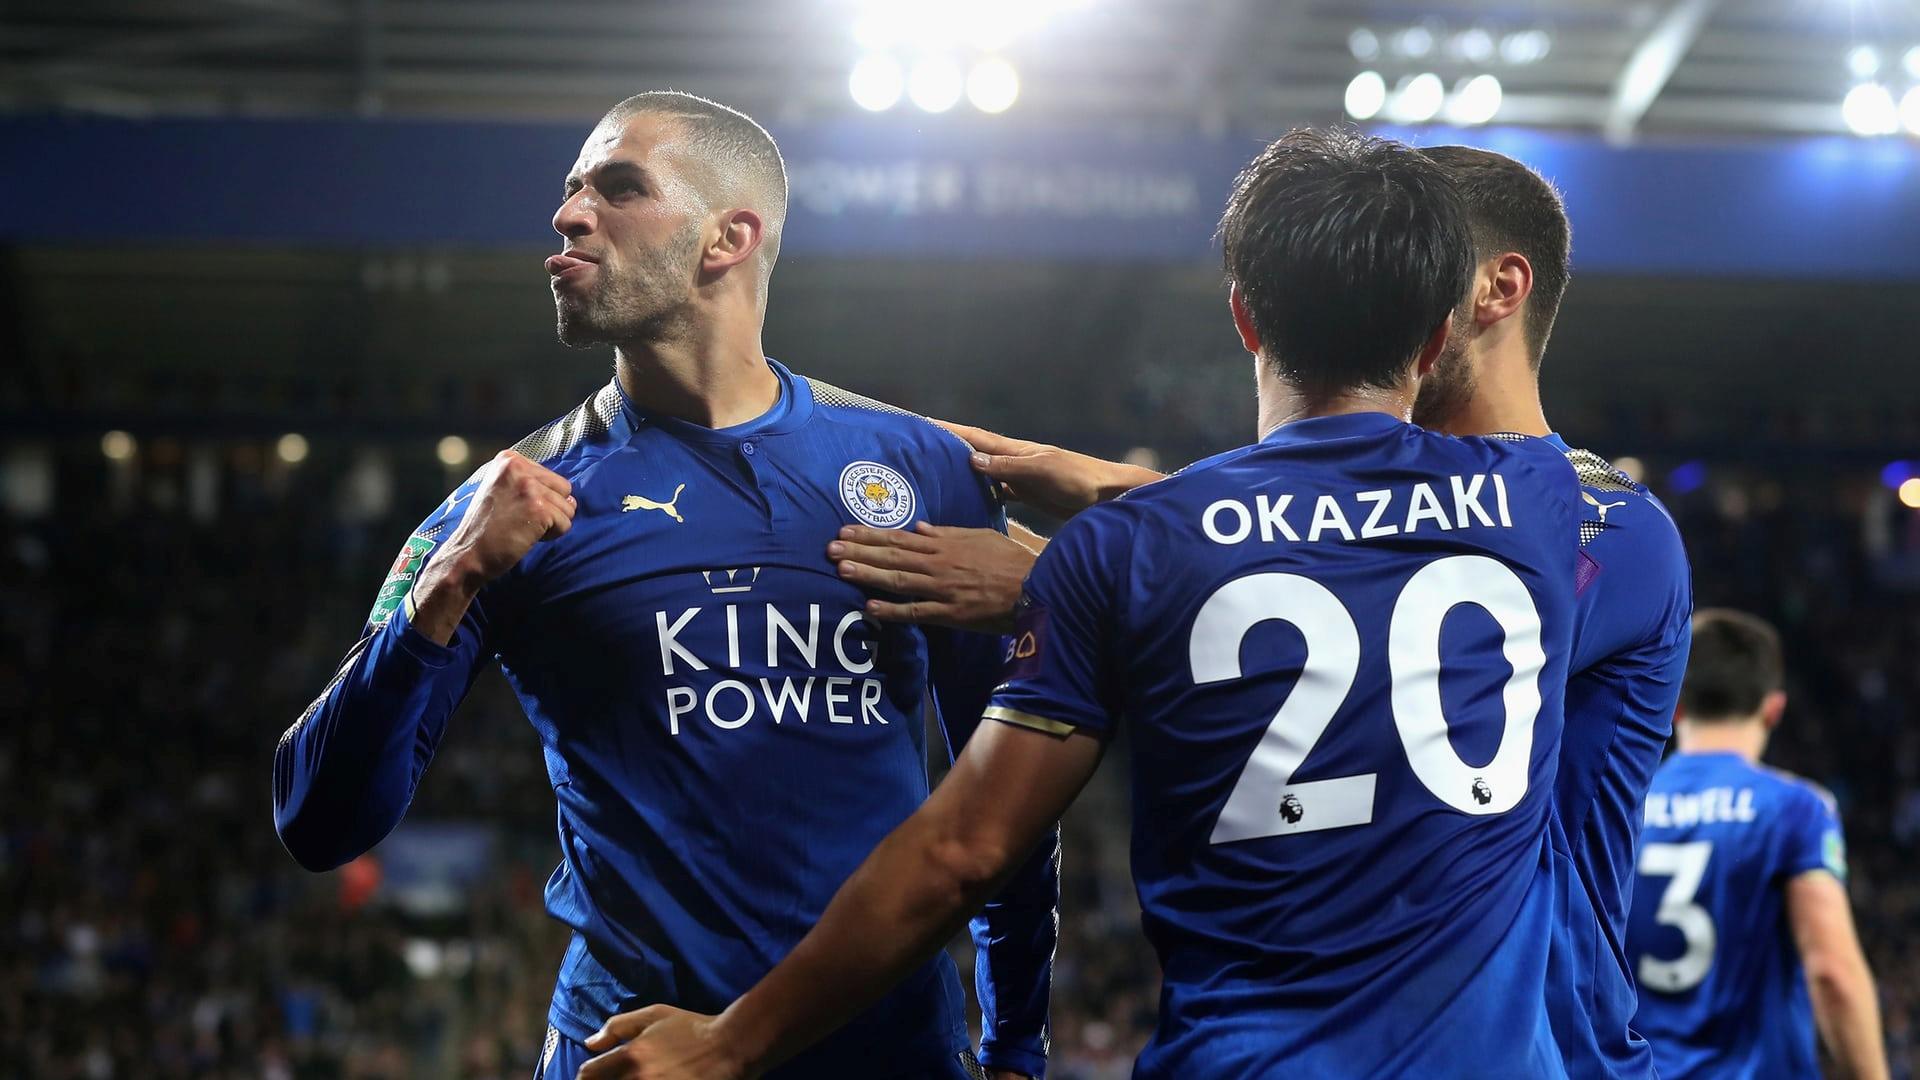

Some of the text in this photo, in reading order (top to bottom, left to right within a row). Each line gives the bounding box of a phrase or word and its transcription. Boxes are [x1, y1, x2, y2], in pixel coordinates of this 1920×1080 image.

[847, 467, 905, 492] LEICESTER CITY
[850, 494, 908, 523] FOOTBALL CLUB
[1202, 474, 1513, 545] OKAZAKI
[656, 603, 882, 675] KING
[667, 676, 889, 735] POWER
[1189, 555, 1547, 845] 20
[1638, 840, 1717, 993] 3
